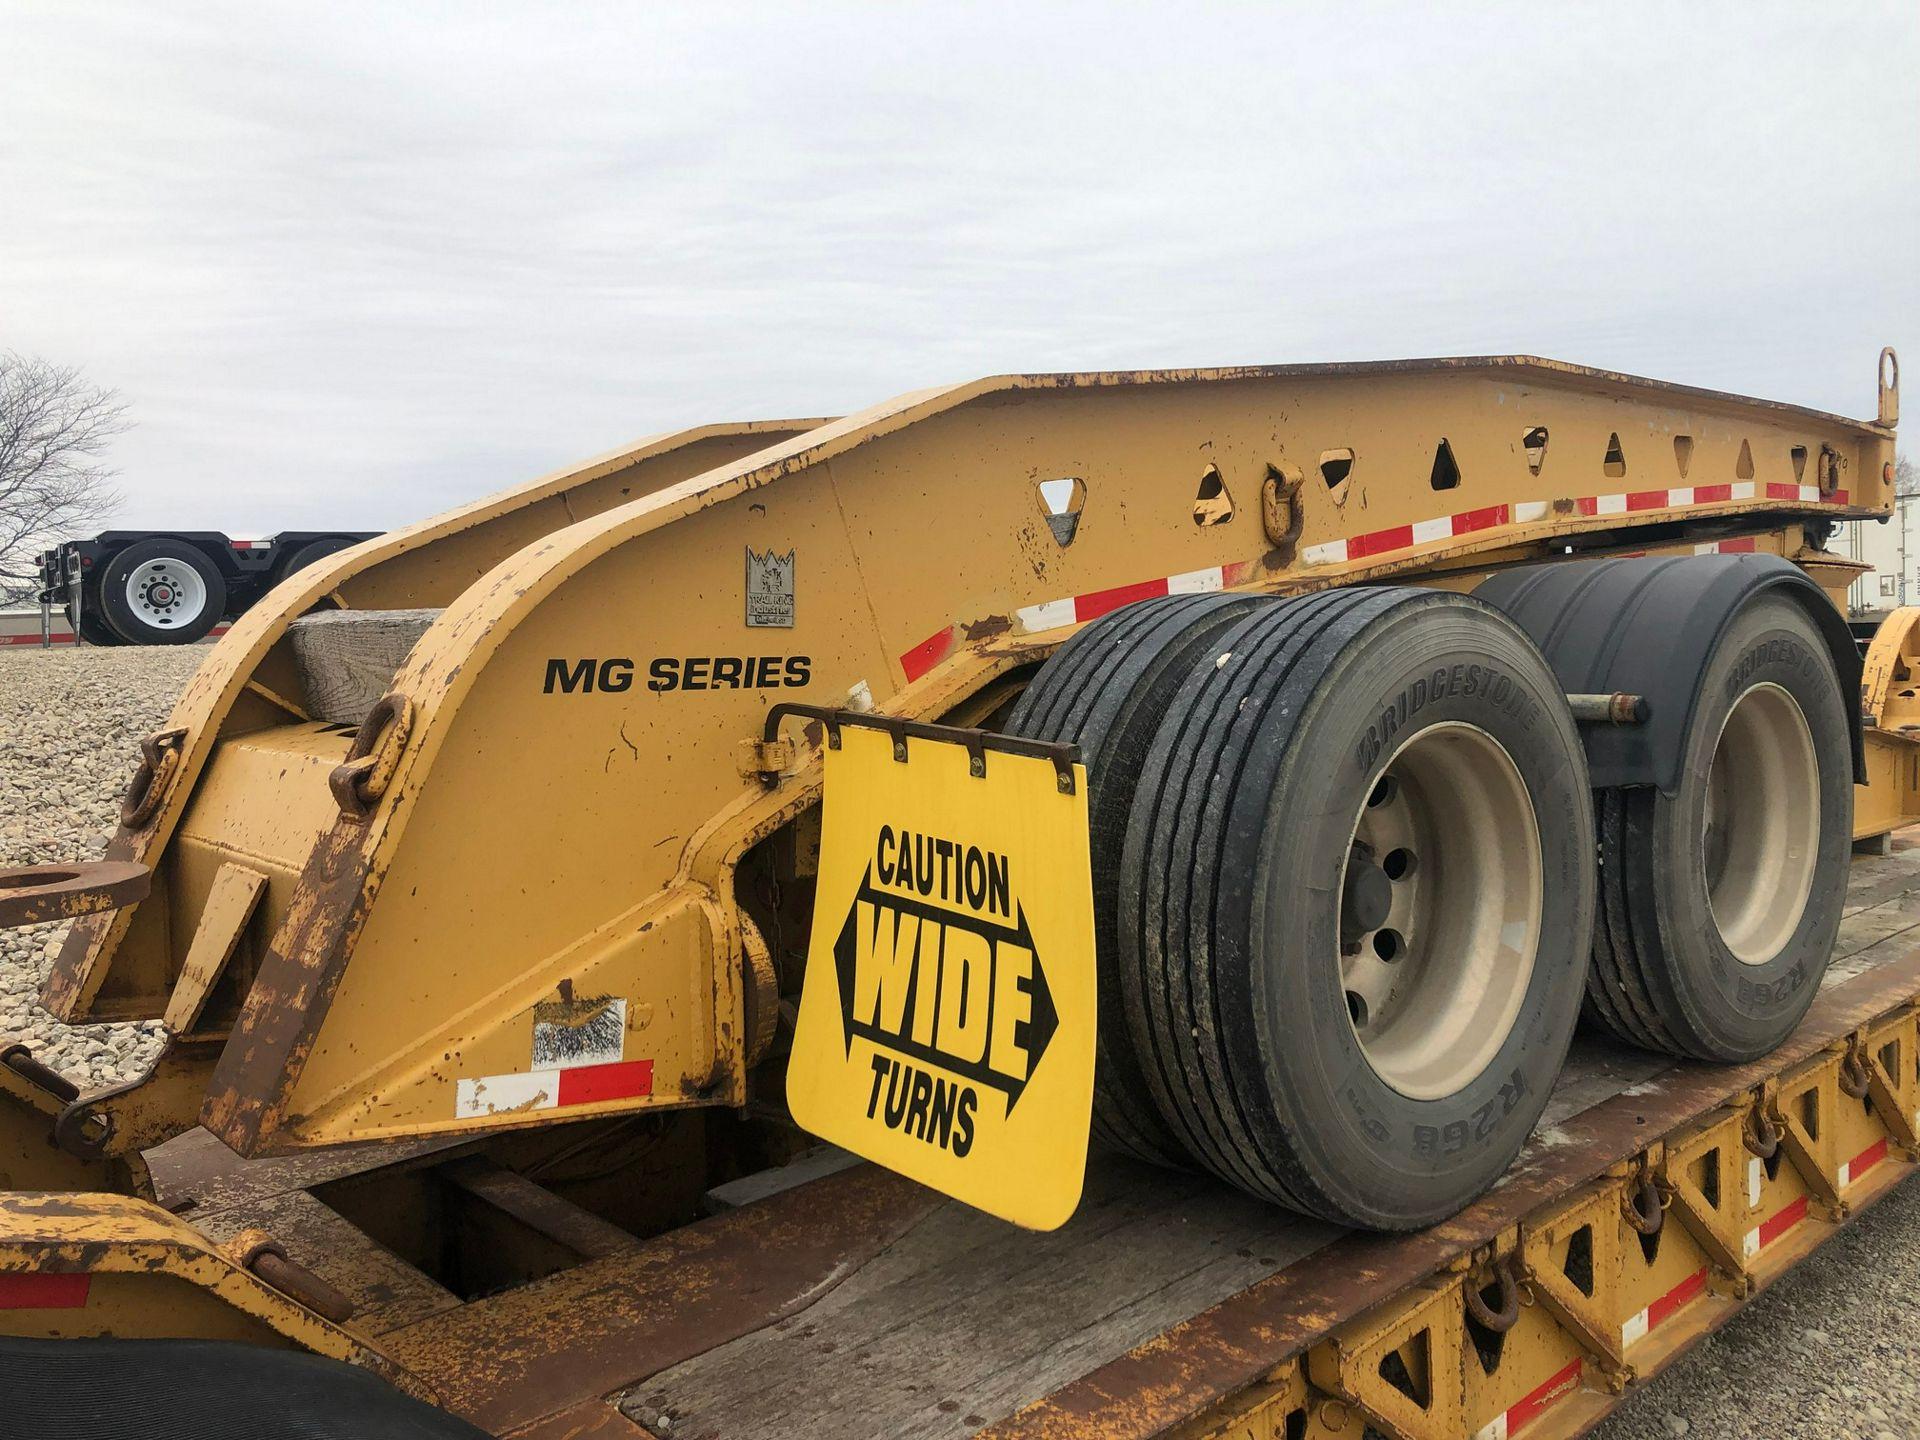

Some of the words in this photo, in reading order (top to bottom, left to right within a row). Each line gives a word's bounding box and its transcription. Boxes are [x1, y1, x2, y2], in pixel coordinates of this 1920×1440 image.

[543, 658, 635, 694] MG
[647, 656, 812, 693] SERIES
[1356, 663, 1541, 782] BRIDGESTONE
[877, 824, 1010, 919] CAUTION
[852, 899, 1034, 1082] WIDE
[866, 1053, 978, 1159] TURNS
[1412, 1067, 1527, 1161] R268
